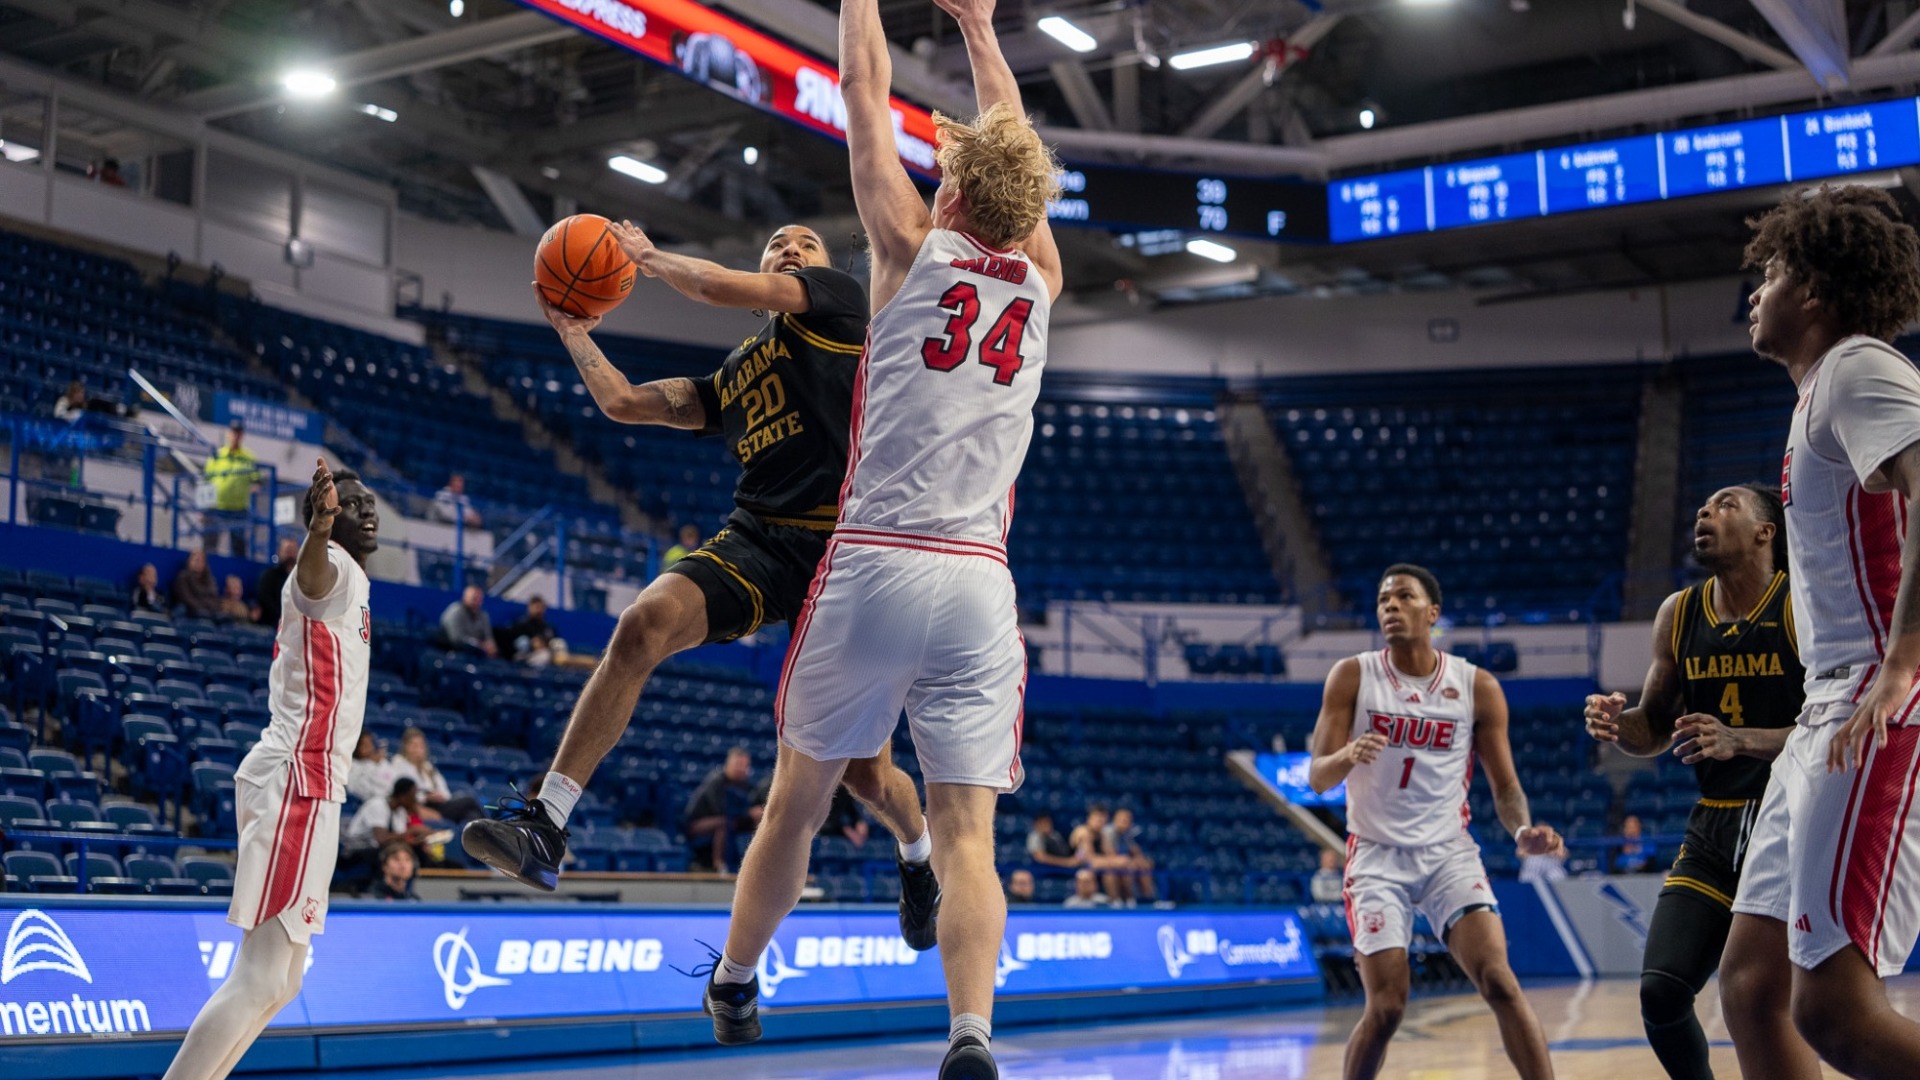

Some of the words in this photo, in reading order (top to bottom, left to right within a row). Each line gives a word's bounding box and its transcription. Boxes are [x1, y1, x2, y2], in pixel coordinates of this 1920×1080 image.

[920, 280, 1035, 387] 34
[720, 337, 792, 411] ALABAMA
[741, 372, 786, 434] 20
[737, 410, 804, 463] STATE
[1685, 652, 1784, 680] ALABAMA
[1719, 683, 1744, 726] 4
[1367, 711, 1457, 750] SIUE
[1399, 757, 1415, 789] 1
[495, 938, 663, 974] BOEING
[794, 936, 918, 967] BOEING
[1017, 932, 1112, 960] BOEING
